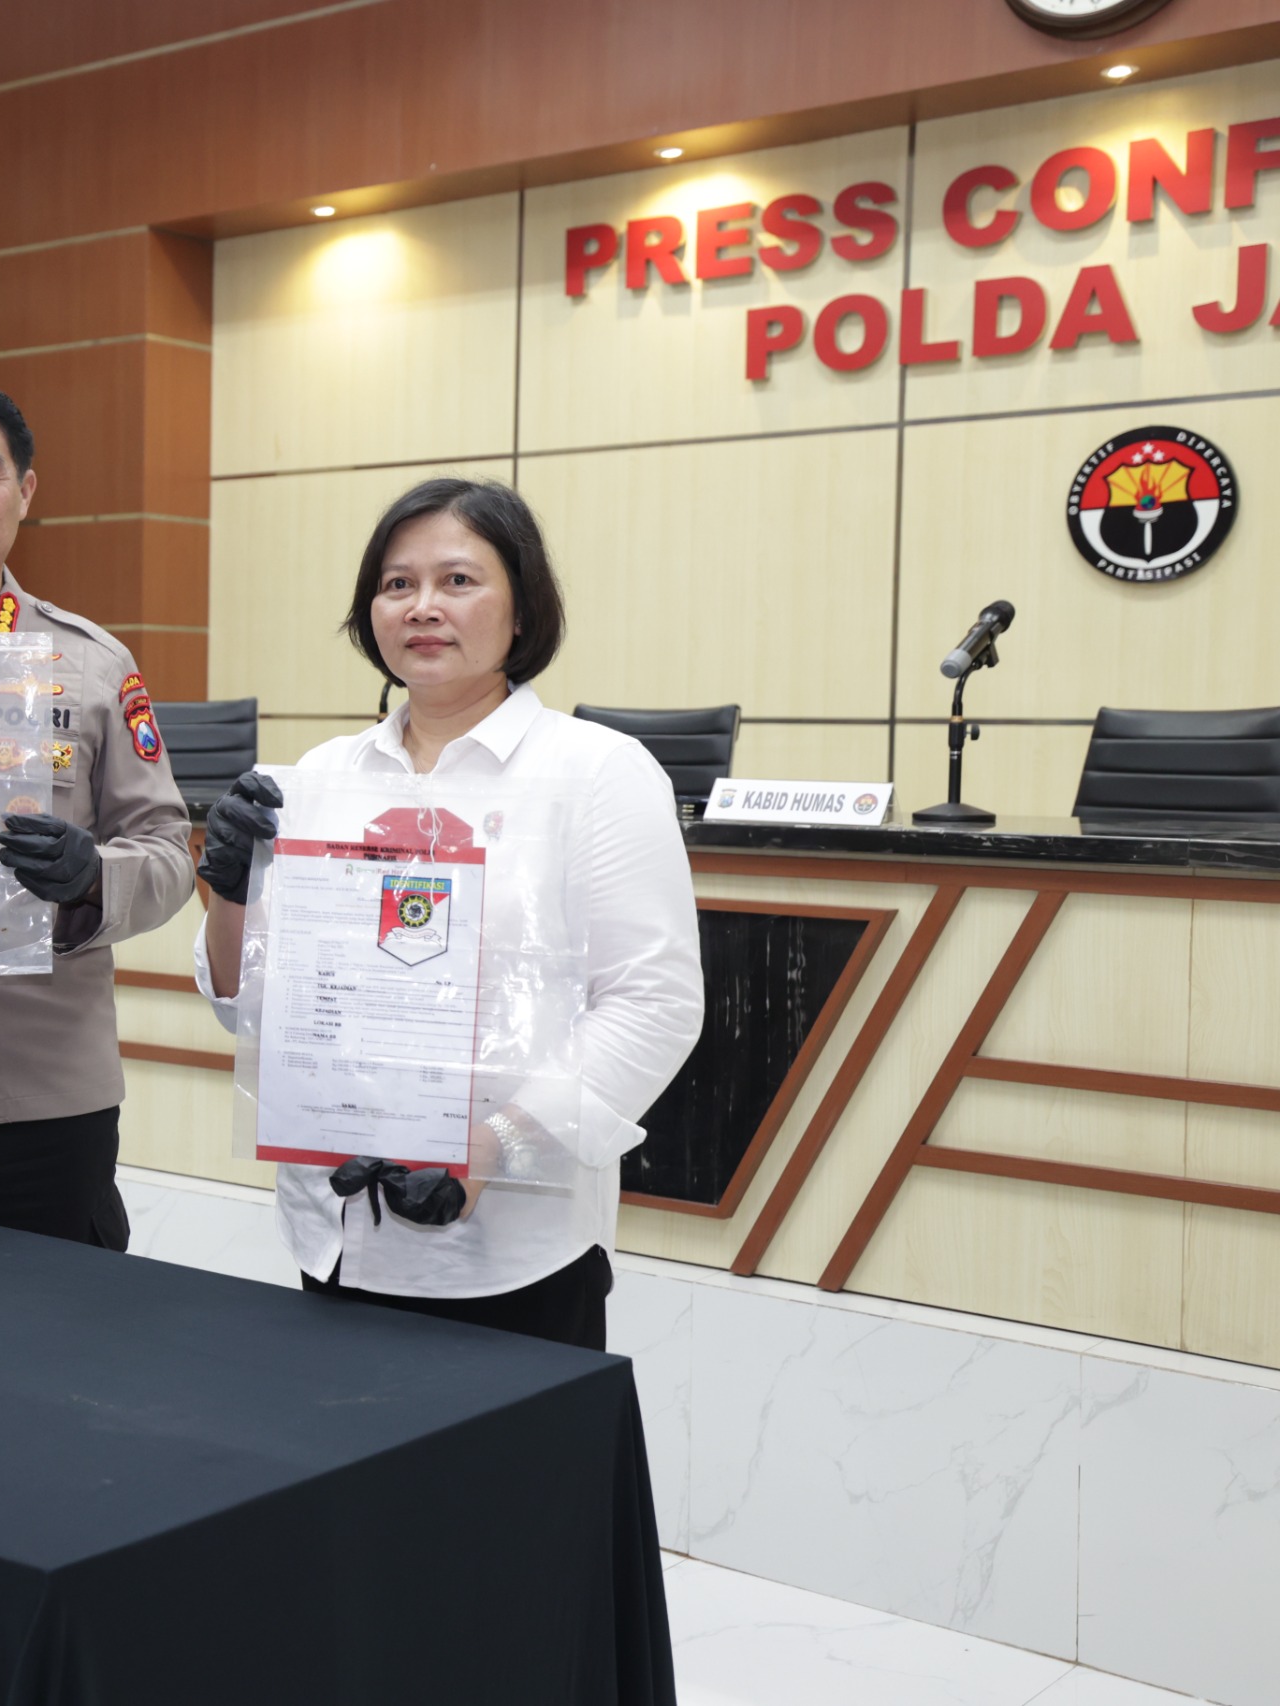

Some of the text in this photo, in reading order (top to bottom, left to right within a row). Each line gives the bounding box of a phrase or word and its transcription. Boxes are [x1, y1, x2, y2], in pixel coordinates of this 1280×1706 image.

[566, 116, 1280, 297] PRESS CONF
[746, 243, 1280, 380] POLDA J
[1068, 442, 1115, 516] OBYEKTIF
[1176, 431, 1233, 509] DIPERCAYA
[741, 790, 846, 813] KABID HUMAS
